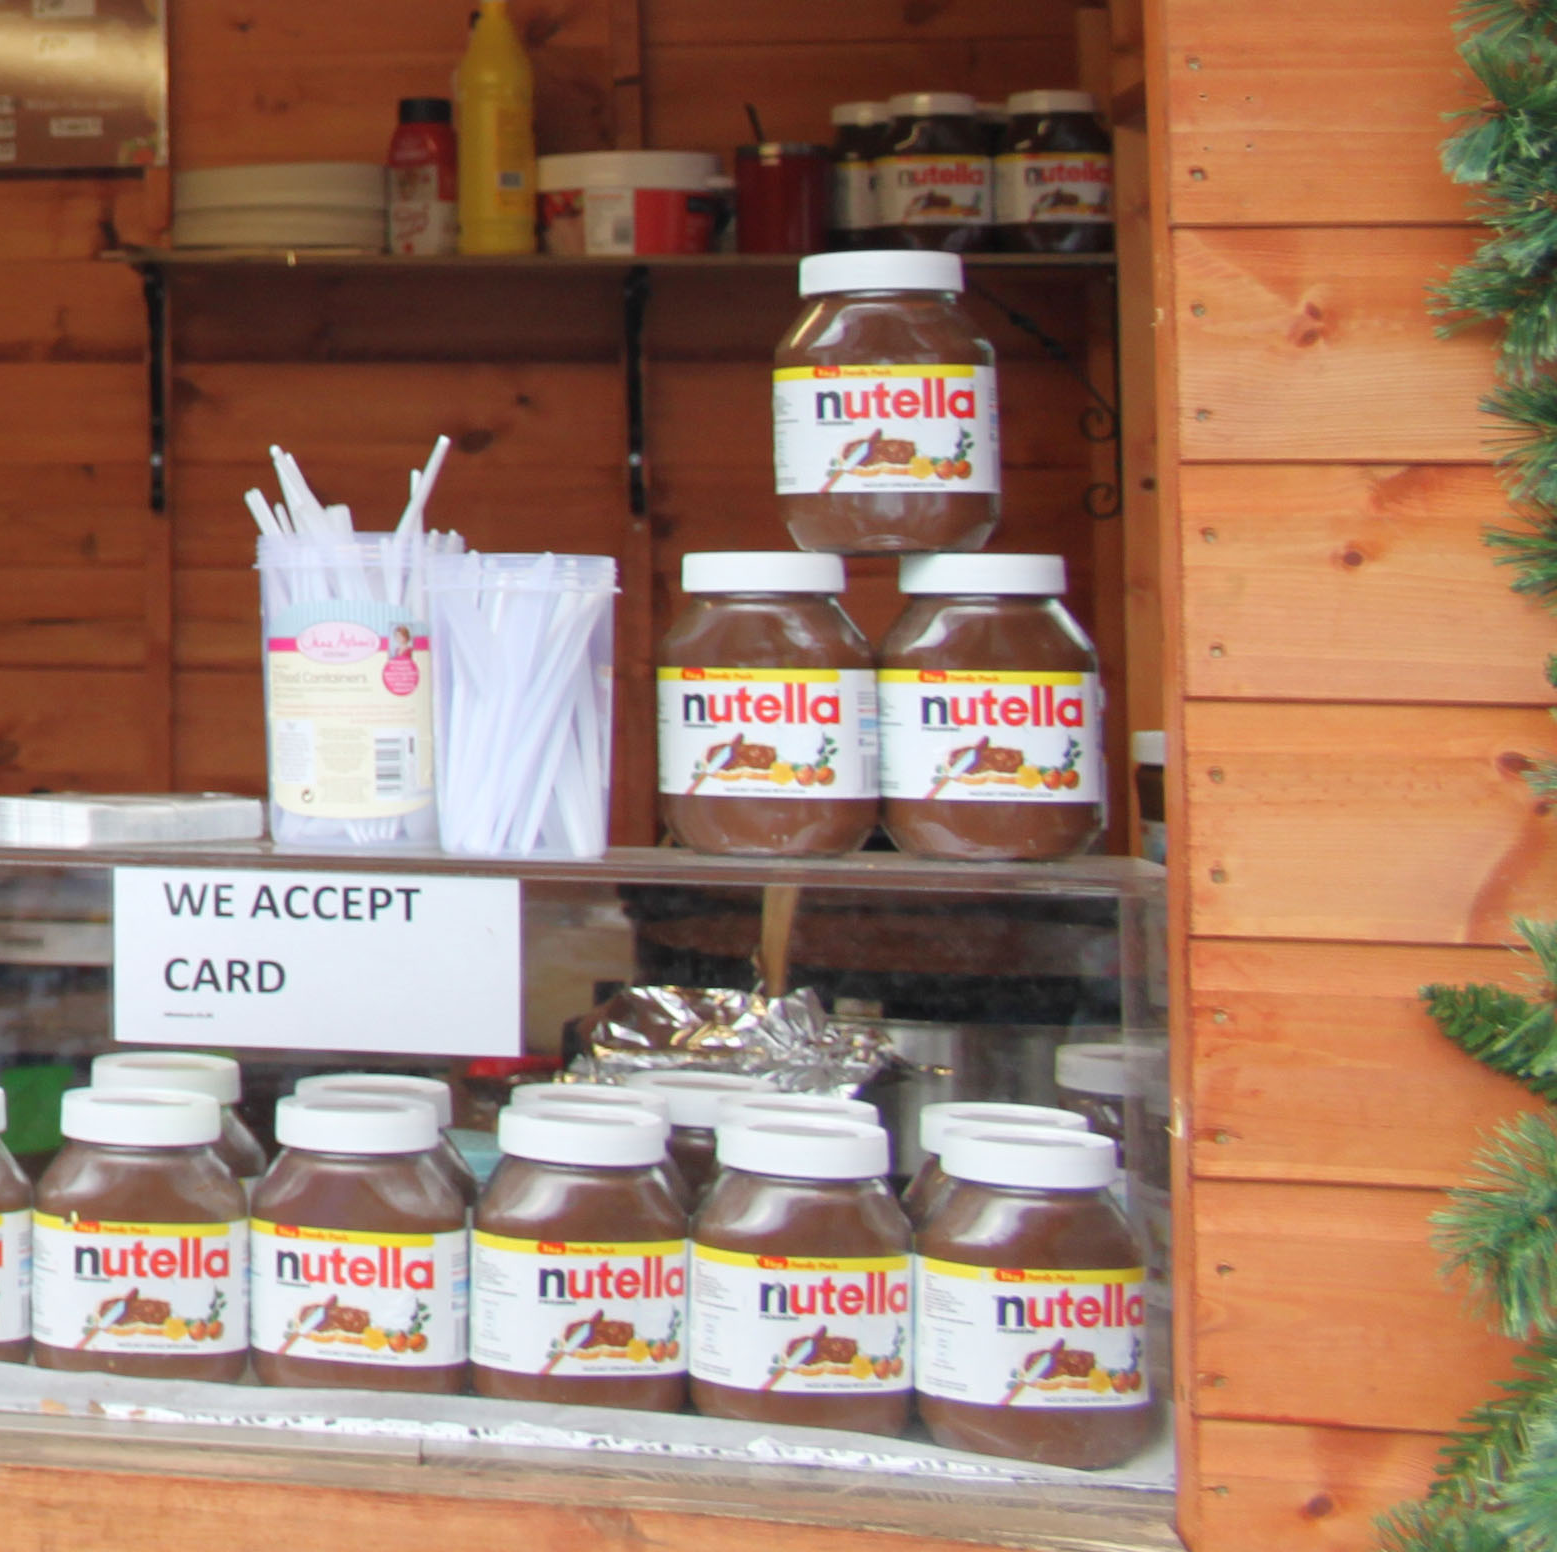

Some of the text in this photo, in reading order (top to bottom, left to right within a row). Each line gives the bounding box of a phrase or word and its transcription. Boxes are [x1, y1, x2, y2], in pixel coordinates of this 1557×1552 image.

[898, 160, 984, 186] nutella
[815, 377, 975, 419] nutella
[683, 682, 840, 724] nutella
[921, 684, 1084, 727] nutella
[164, 881, 421, 922] WE ACCEPT
[163, 957, 287, 994] CARD
[75, 1237, 230, 1279] nutella
[277, 1245, 434, 1290] nutella
[539, 1255, 684, 1299] nutella
[759, 1271, 908, 1315] nutella
[996, 1282, 1146, 1328] nutella
